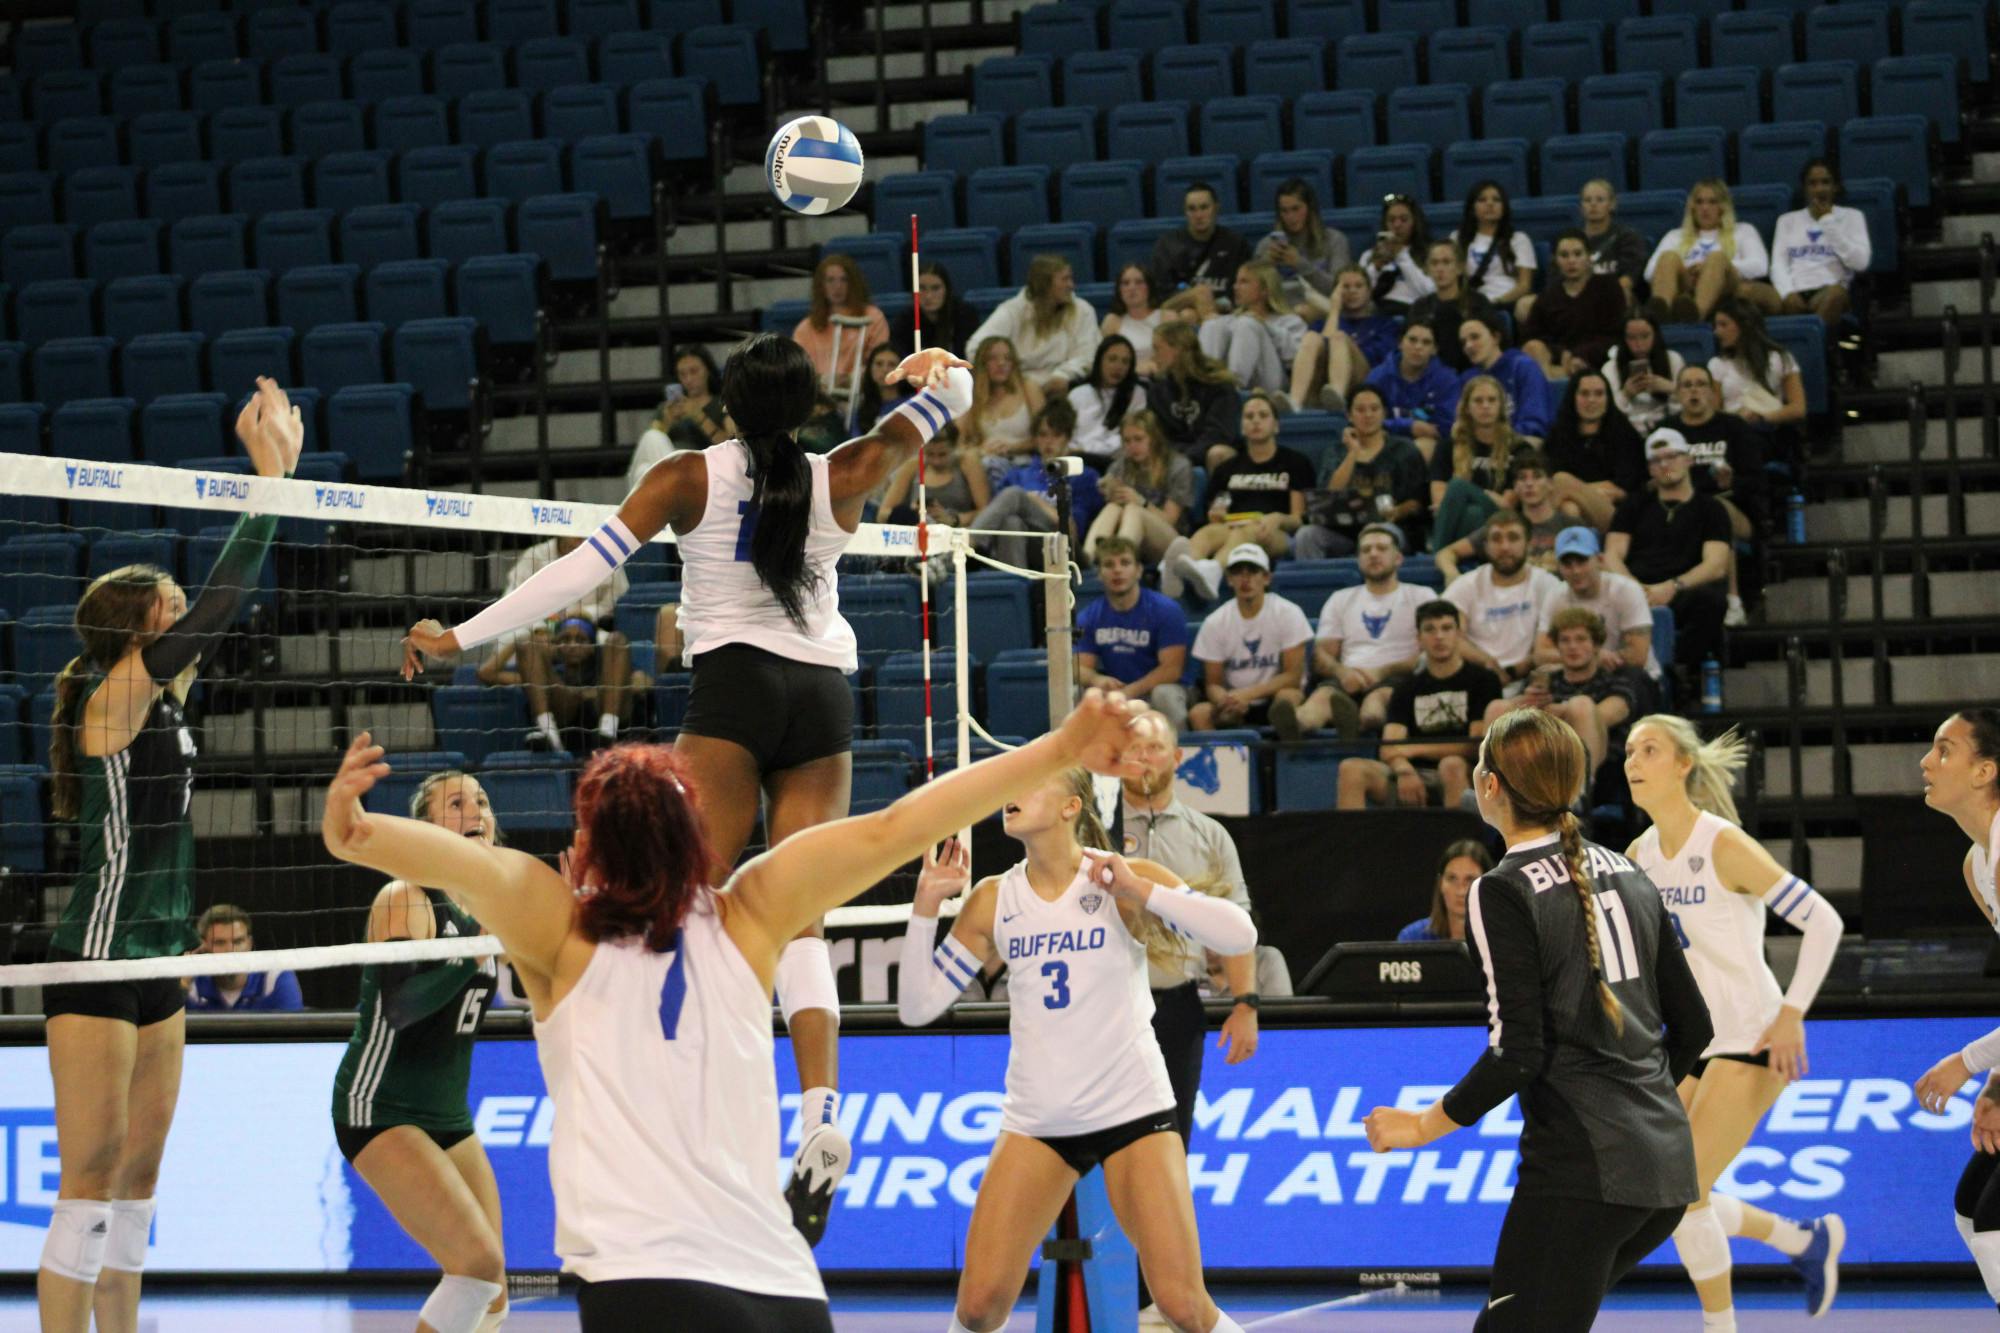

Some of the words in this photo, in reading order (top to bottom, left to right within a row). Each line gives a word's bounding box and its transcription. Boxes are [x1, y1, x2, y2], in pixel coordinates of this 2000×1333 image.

[773, 135, 791, 189] molten
[1008, 926, 1106, 959] BUFFALO
[1041, 960, 1071, 1010] 3
[1379, 961, 1422, 983] POSS
[456, 987, 489, 1034] 15
[1359, 1272, 1441, 1282] DAKTRONICS
